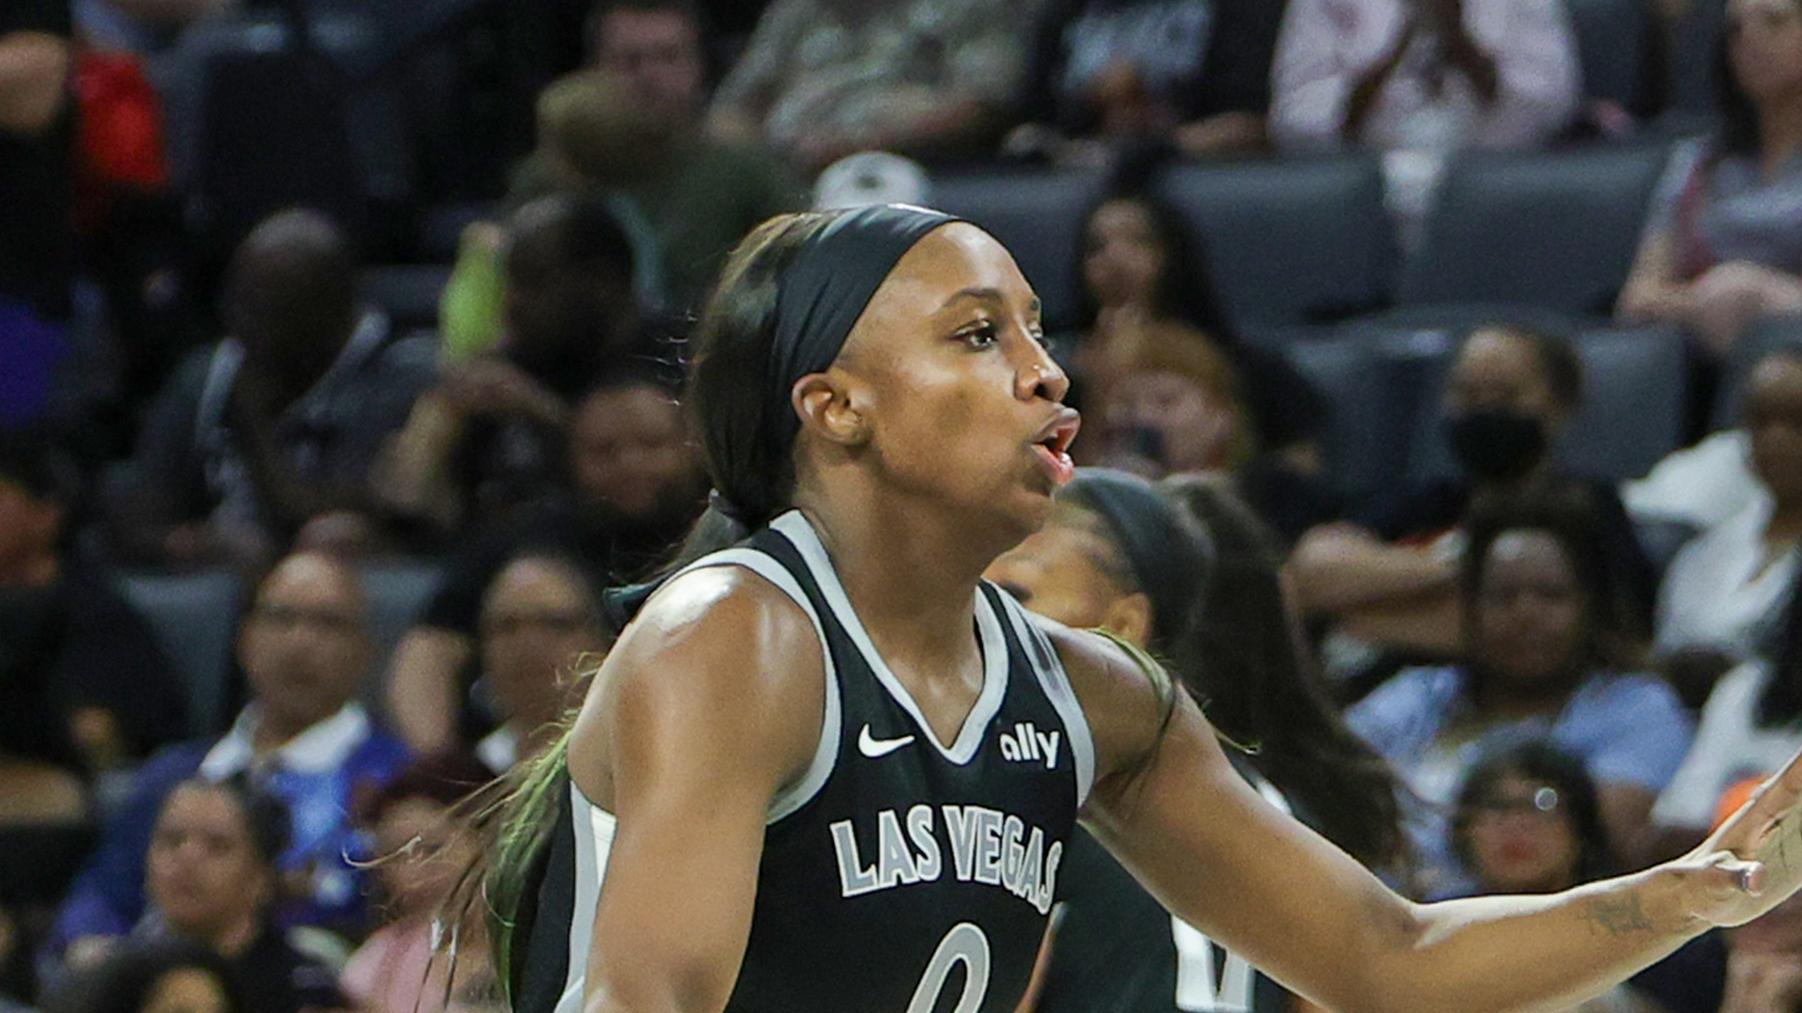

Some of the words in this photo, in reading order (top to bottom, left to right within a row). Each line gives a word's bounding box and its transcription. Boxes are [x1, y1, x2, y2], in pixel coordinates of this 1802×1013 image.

[1000, 723, 1060, 769] ally
[830, 804, 941, 898] LAS
[942, 805, 1063, 915] VEGAS
